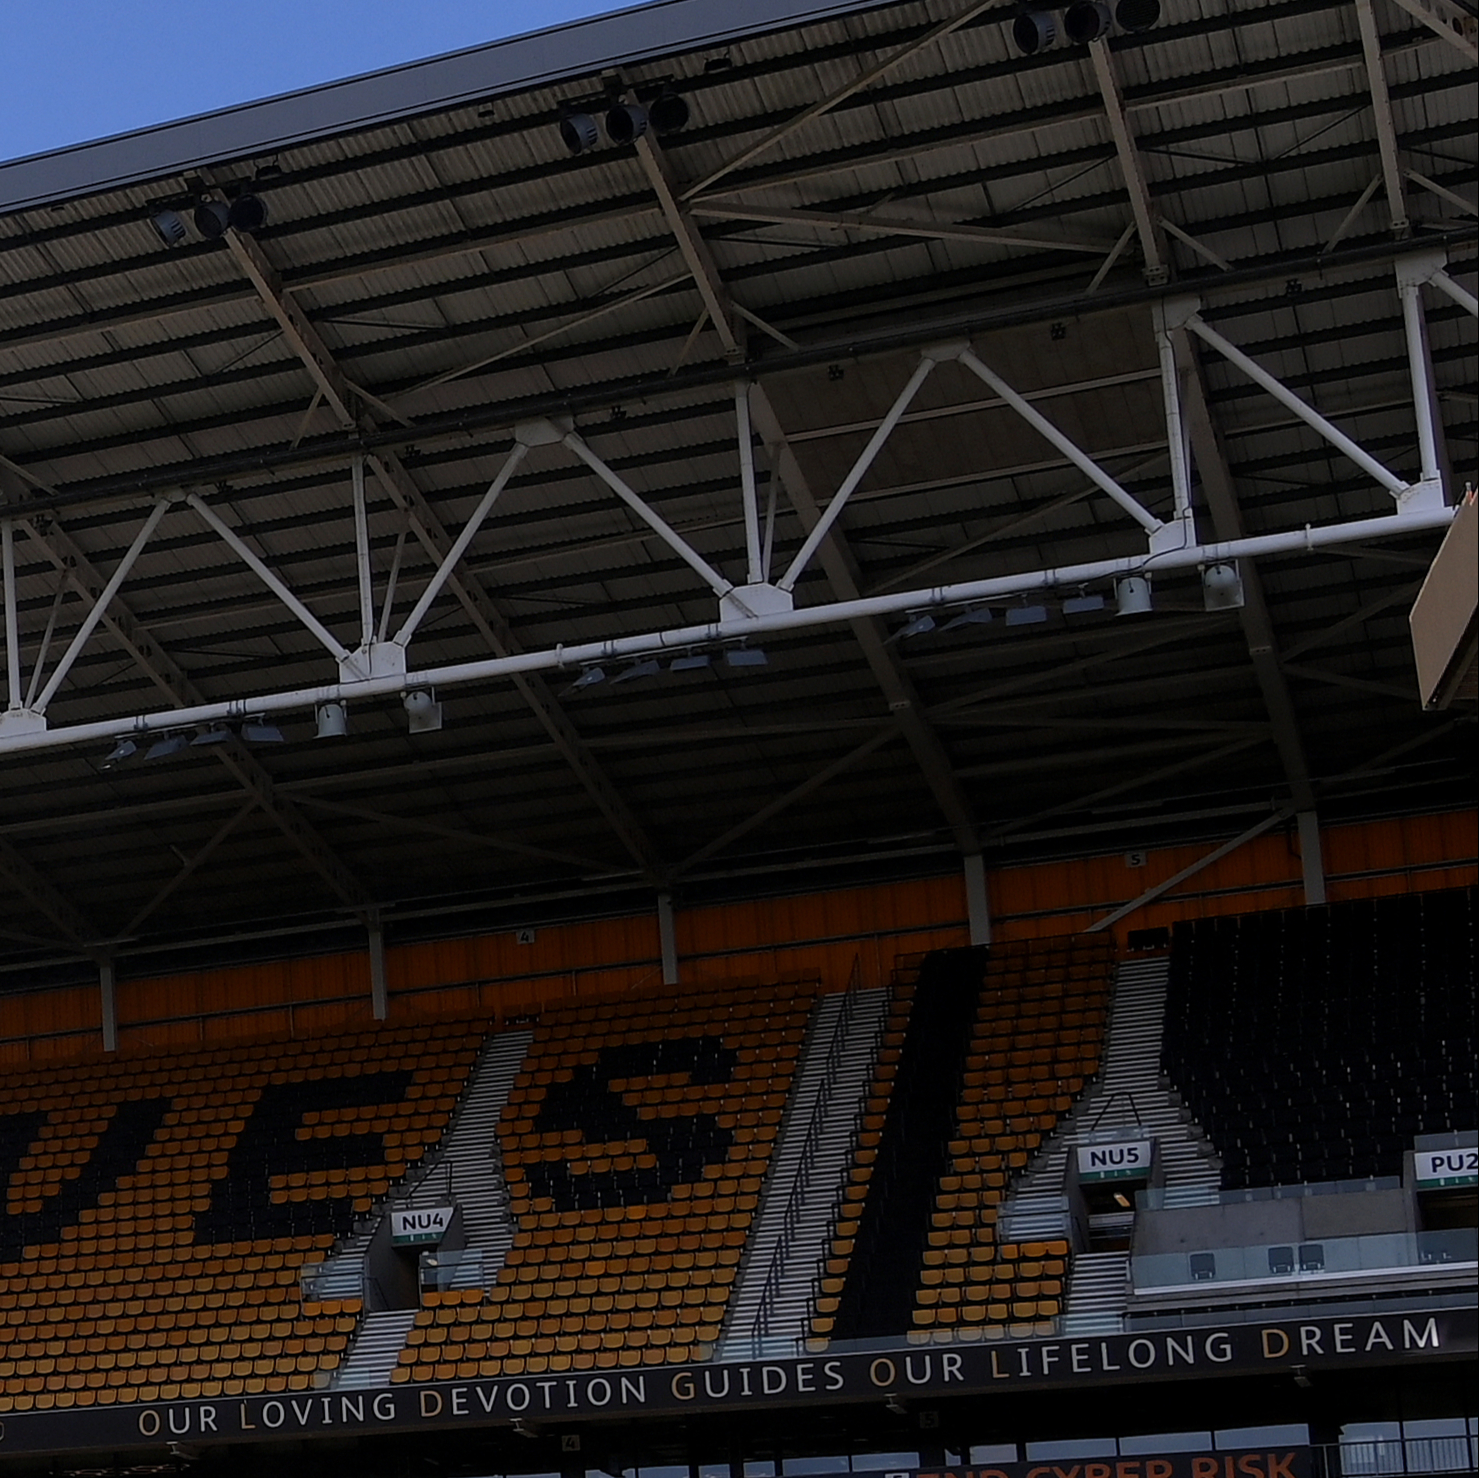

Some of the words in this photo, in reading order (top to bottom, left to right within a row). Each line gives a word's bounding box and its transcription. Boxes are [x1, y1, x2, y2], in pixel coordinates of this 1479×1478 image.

[1089, 1147, 1140, 1168] NU5
[1431, 1153, 1479, 1174] PU2
[402, 1212, 444, 1231] NU4
[138, 1405, 219, 1437] OUR
[240, 1393, 396, 1430] LOVING
[419, 1374, 646, 1418] DEVOTION
[670, 1360, 843, 1400] GUIDES
[869, 1352, 964, 1387] OUR
[990, 1332, 1234, 1378] LIFELONG
[1261, 1316, 1441, 1358] DREAM
